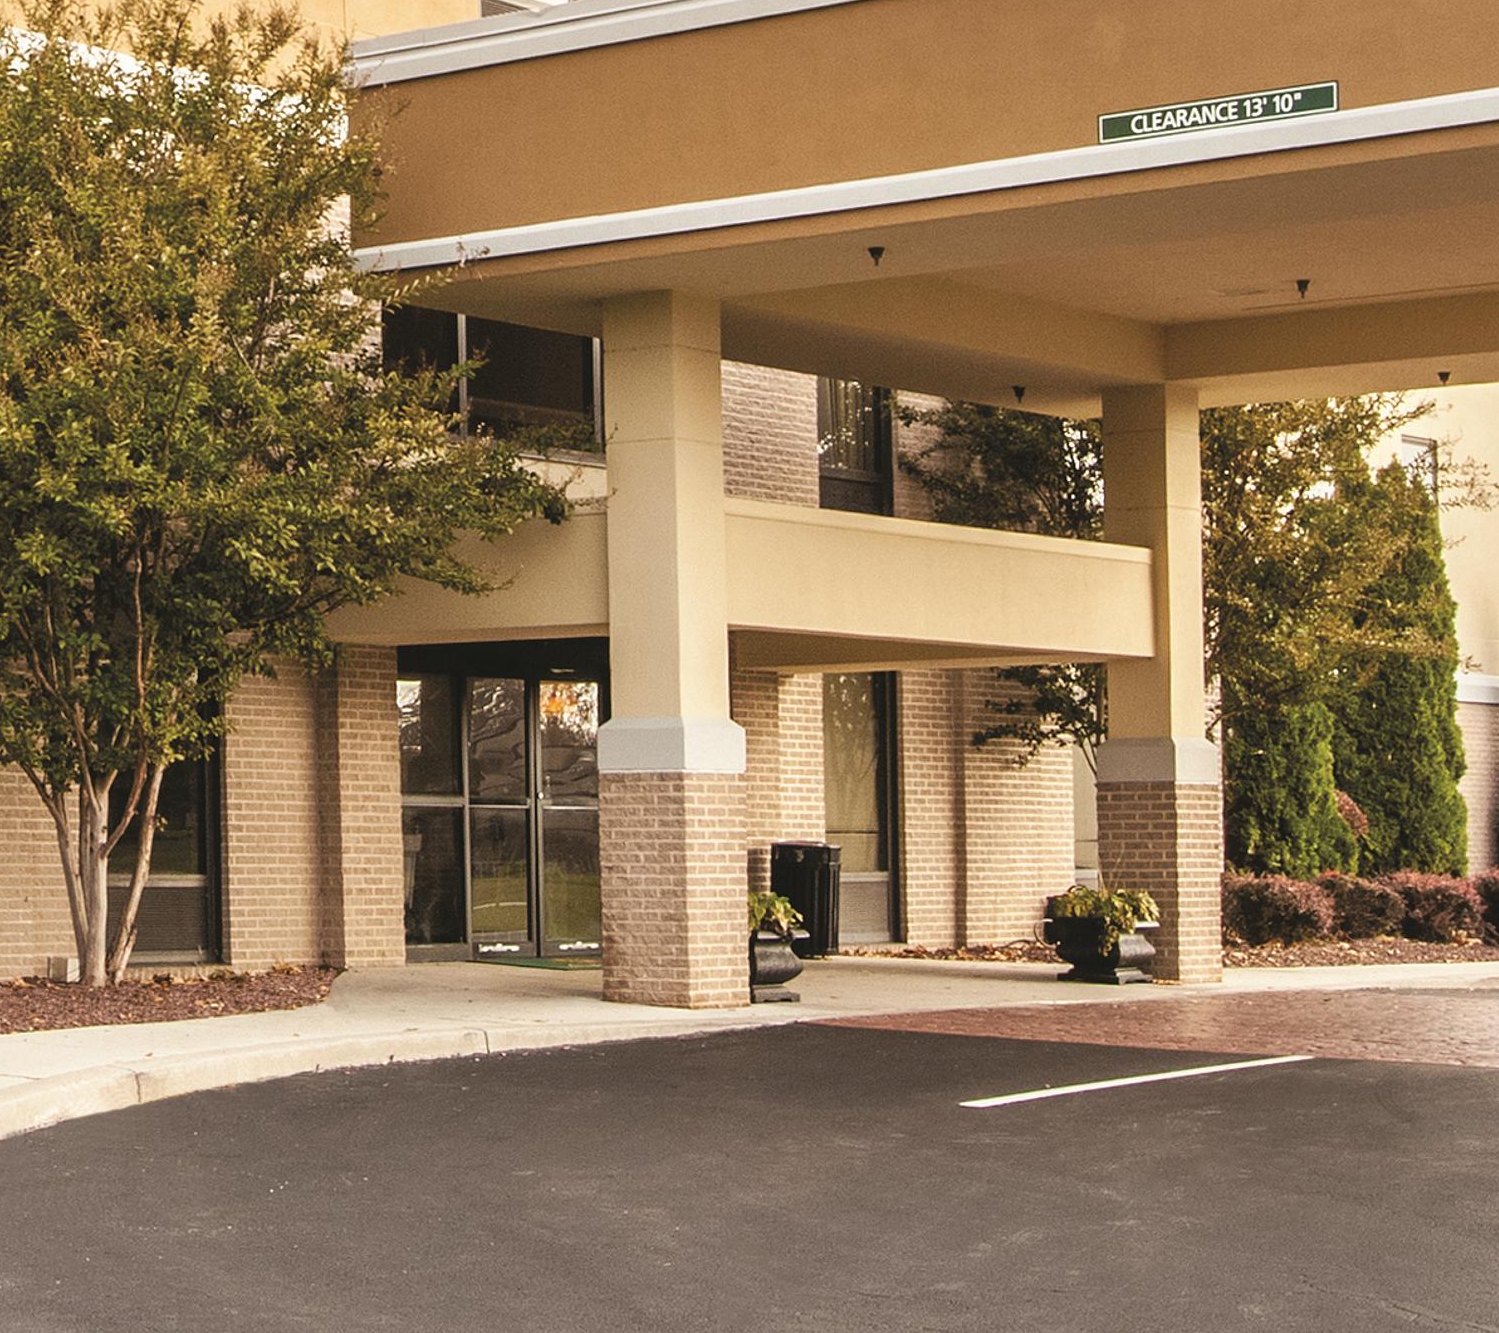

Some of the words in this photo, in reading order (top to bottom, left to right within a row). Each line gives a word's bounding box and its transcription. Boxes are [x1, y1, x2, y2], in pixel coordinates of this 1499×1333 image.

[1130, 101, 1239, 134] CLEARANCE
[1243, 97, 1268, 118] 13'
[1272, 92, 1302, 113] 10"
